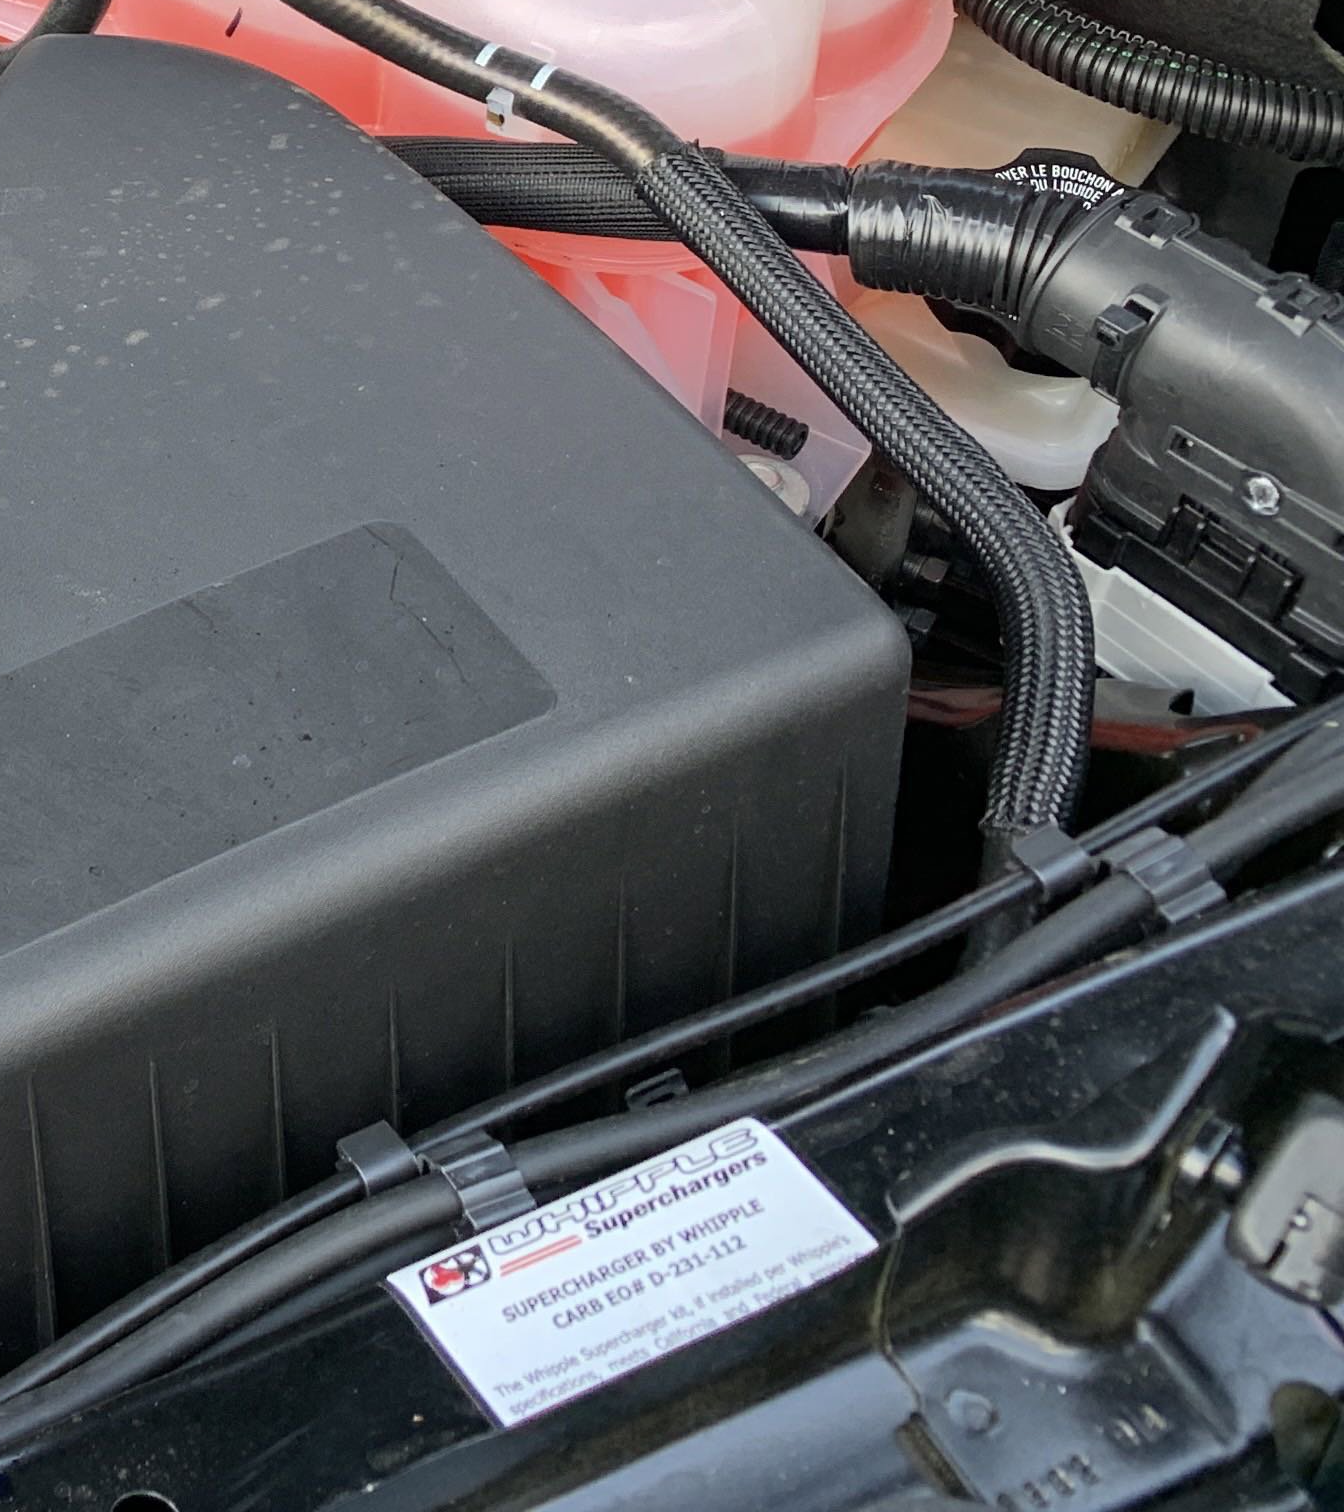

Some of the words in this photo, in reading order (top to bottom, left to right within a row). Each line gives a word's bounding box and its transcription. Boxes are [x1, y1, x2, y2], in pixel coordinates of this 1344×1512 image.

[1031, 164, 1047, 177] LE
[1052, 165, 1115, 193] BOUCHON
[1053, 180, 1103, 203] LIQUIDE
[482, 1124, 764, 1260] WHIPPLE
[578, 1147, 773, 1243] Superchargers
[497, 1245, 653, 1326] SUPERCHARGER
[647, 1234, 682, 1258] BY
[677, 1196, 768, 1245] WHIPPLE
[548, 1296, 606, 1330] CARB
[601, 1277, 648, 1306] EO#
[645, 1232, 749, 1289] D-231-112
[492, 1376, 525, 1398] The
[521, 1351, 583, 1389] Whipple
[576, 1310, 670, 1363] Supercharger
[702, 1268, 763, 1303] installed
[759, 1259, 788, 1279] per
[783, 1229, 853, 1270] Whipple's
[507, 1365, 601, 1418] specifications,
[603, 1343, 649, 1371] meets
[649, 1312, 717, 1350] California
